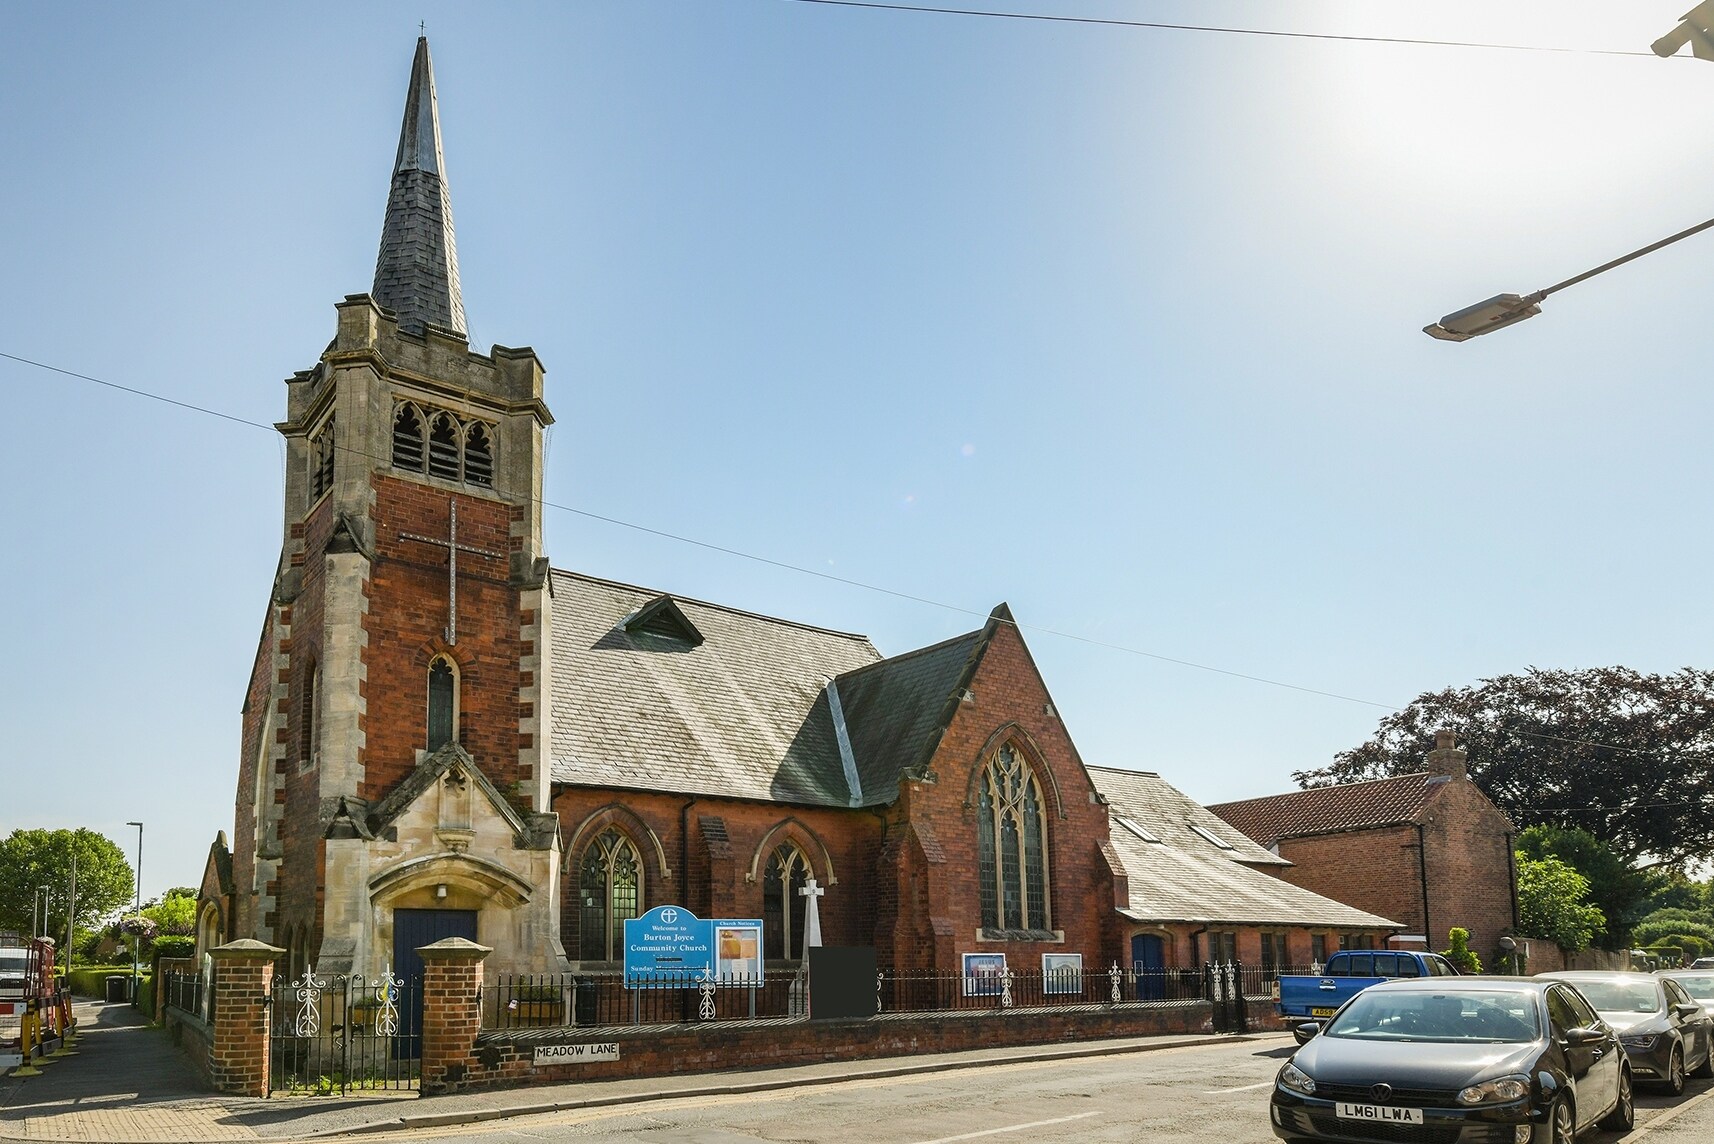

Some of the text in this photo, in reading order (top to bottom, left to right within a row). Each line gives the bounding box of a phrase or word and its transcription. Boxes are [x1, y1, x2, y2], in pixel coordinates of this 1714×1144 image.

[644, 933, 695, 942] Burton Joyce
[630, 944, 707, 953] Community Church
[630, 965, 654, 973] Sunday
[537, 1044, 616, 1057] MEADOW LANE
[1344, 1104, 1413, 1121] LM61 LWA
